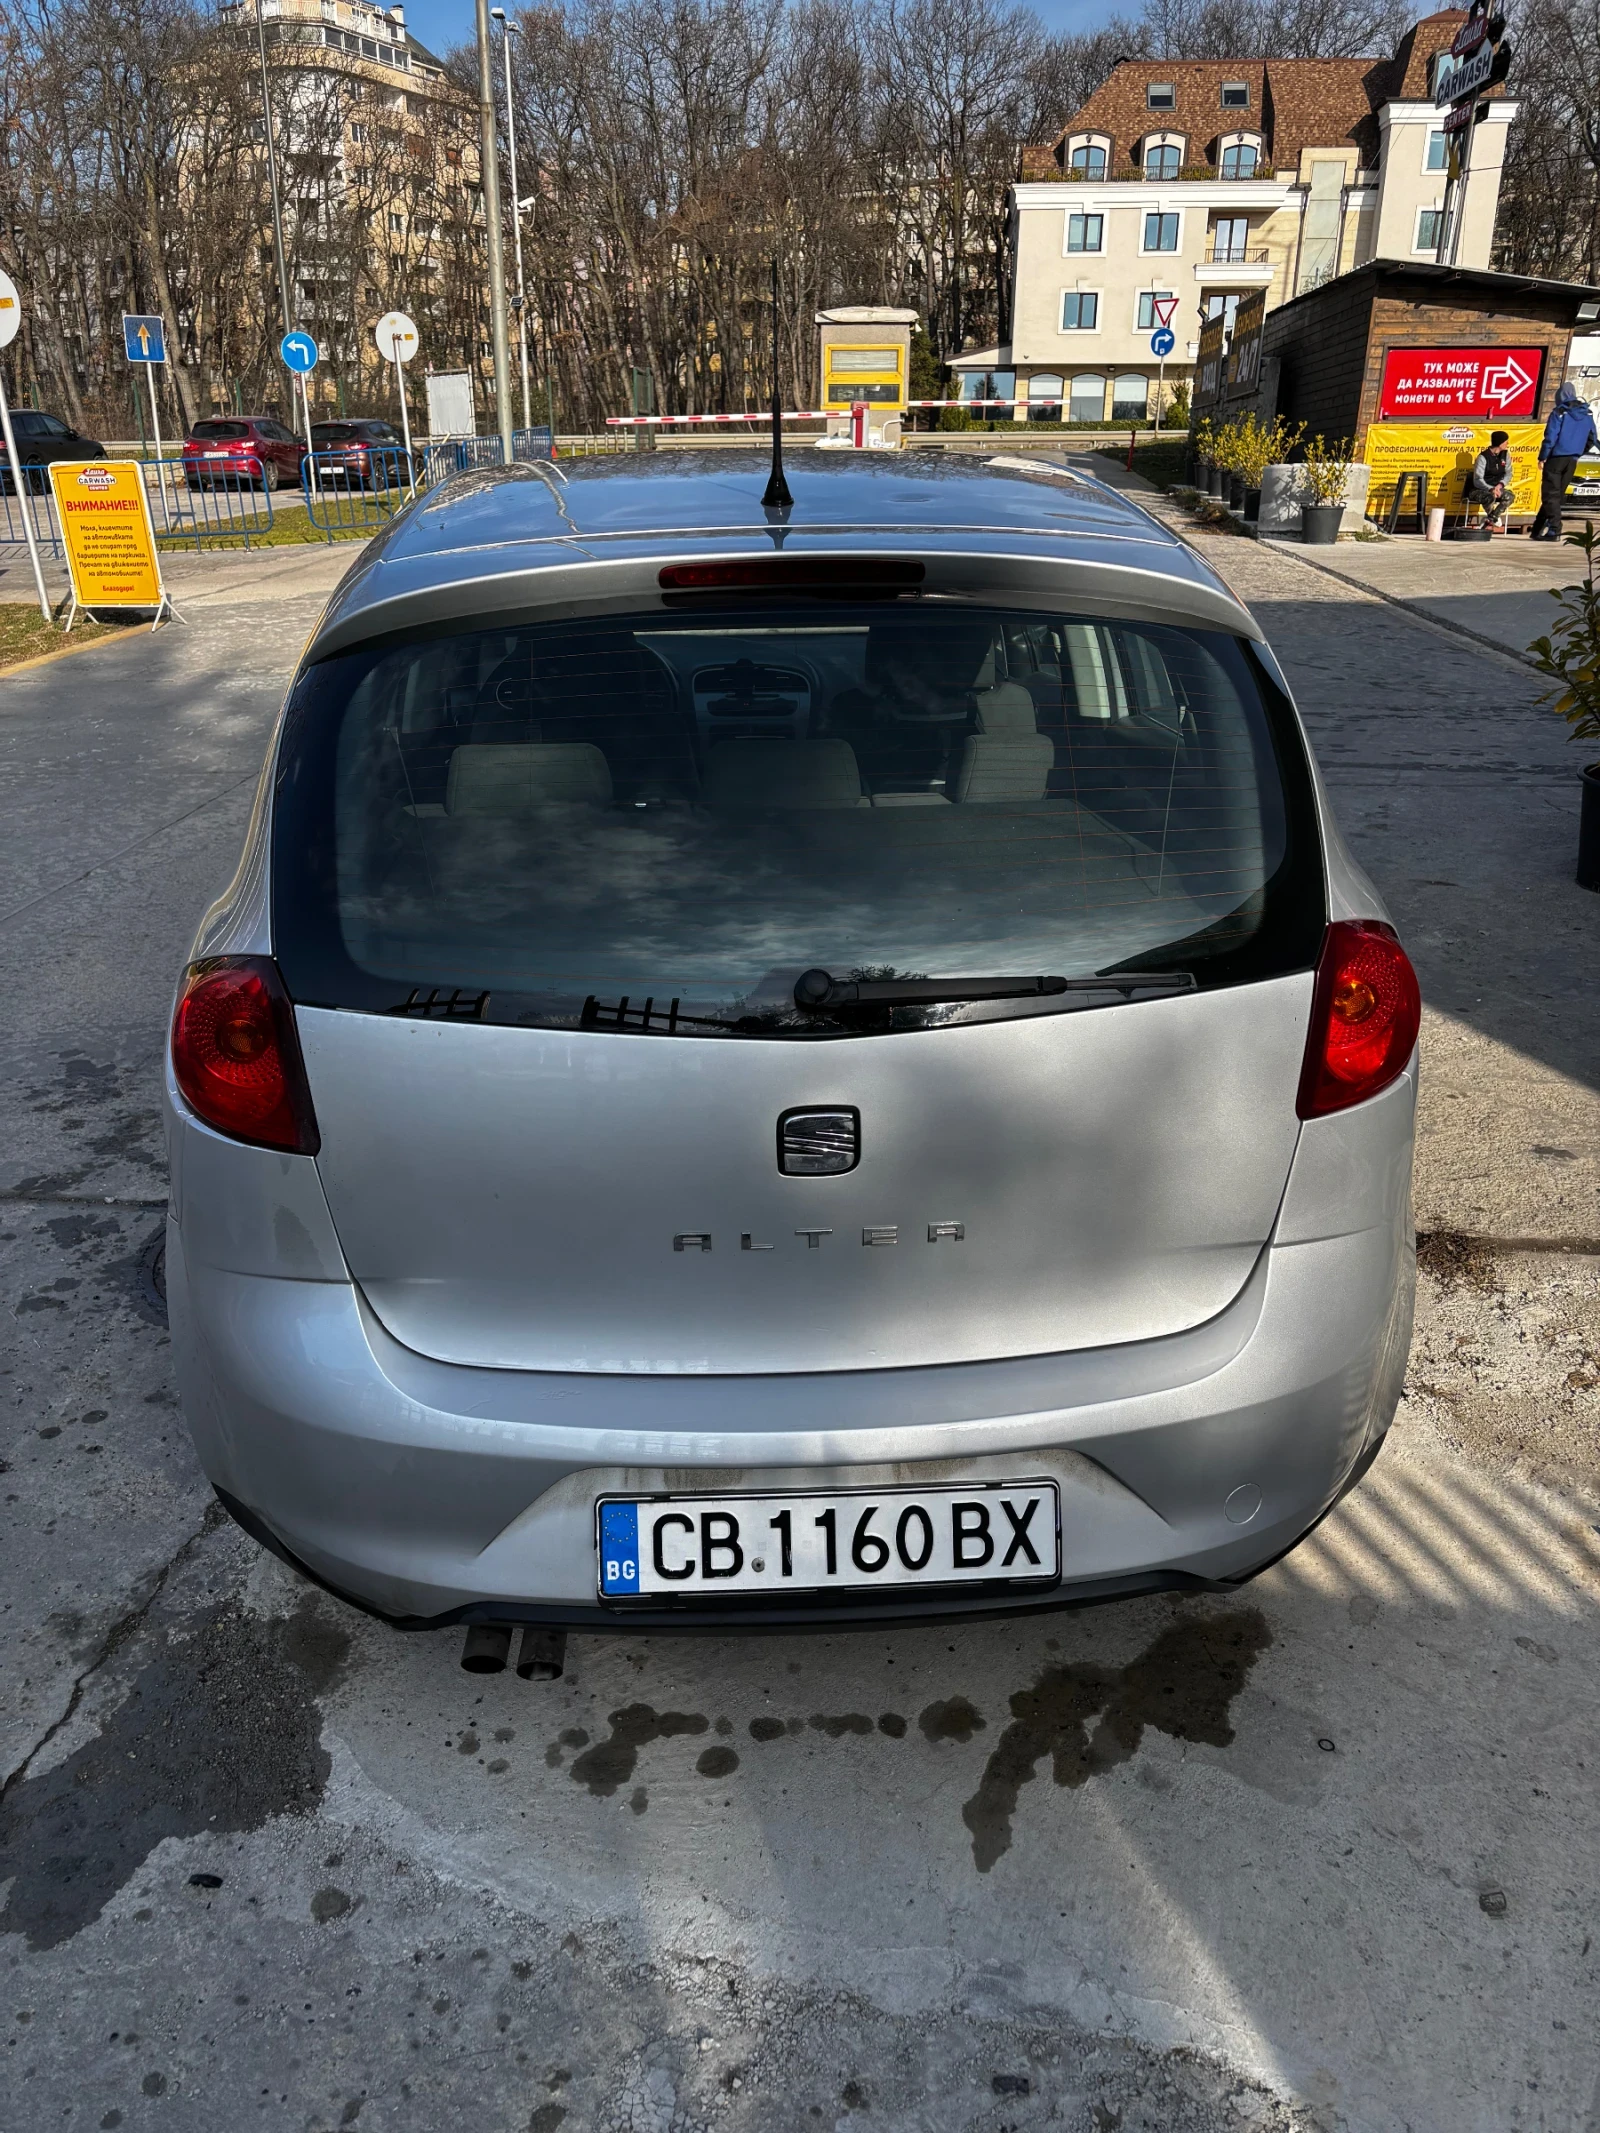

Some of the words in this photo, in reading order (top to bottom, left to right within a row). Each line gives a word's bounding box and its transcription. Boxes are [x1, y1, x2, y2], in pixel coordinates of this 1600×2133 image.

[1437, 50, 1492, 106] CARWASH
[1444, 105, 1471, 131] CENTER
[1424, 362, 1443, 374] ТУК
[1446, 362, 1480, 374] МОЖЕ
[1397, 378, 1412, 390] ДА
[1416, 378, 1478, 389] РАЗВАЛИТЕ
[1455, 390, 1476, 403] 1€
[66, 500, 139, 512] ВНИМАНИЕ!!!
[673, 1220, 965, 1252] ALTEA
[652, 1511, 744, 1580] CB
[769, 1504, 934, 1577] 1160
[951, 1498, 1041, 1569] BX
[606, 1559, 636, 1581] BG
